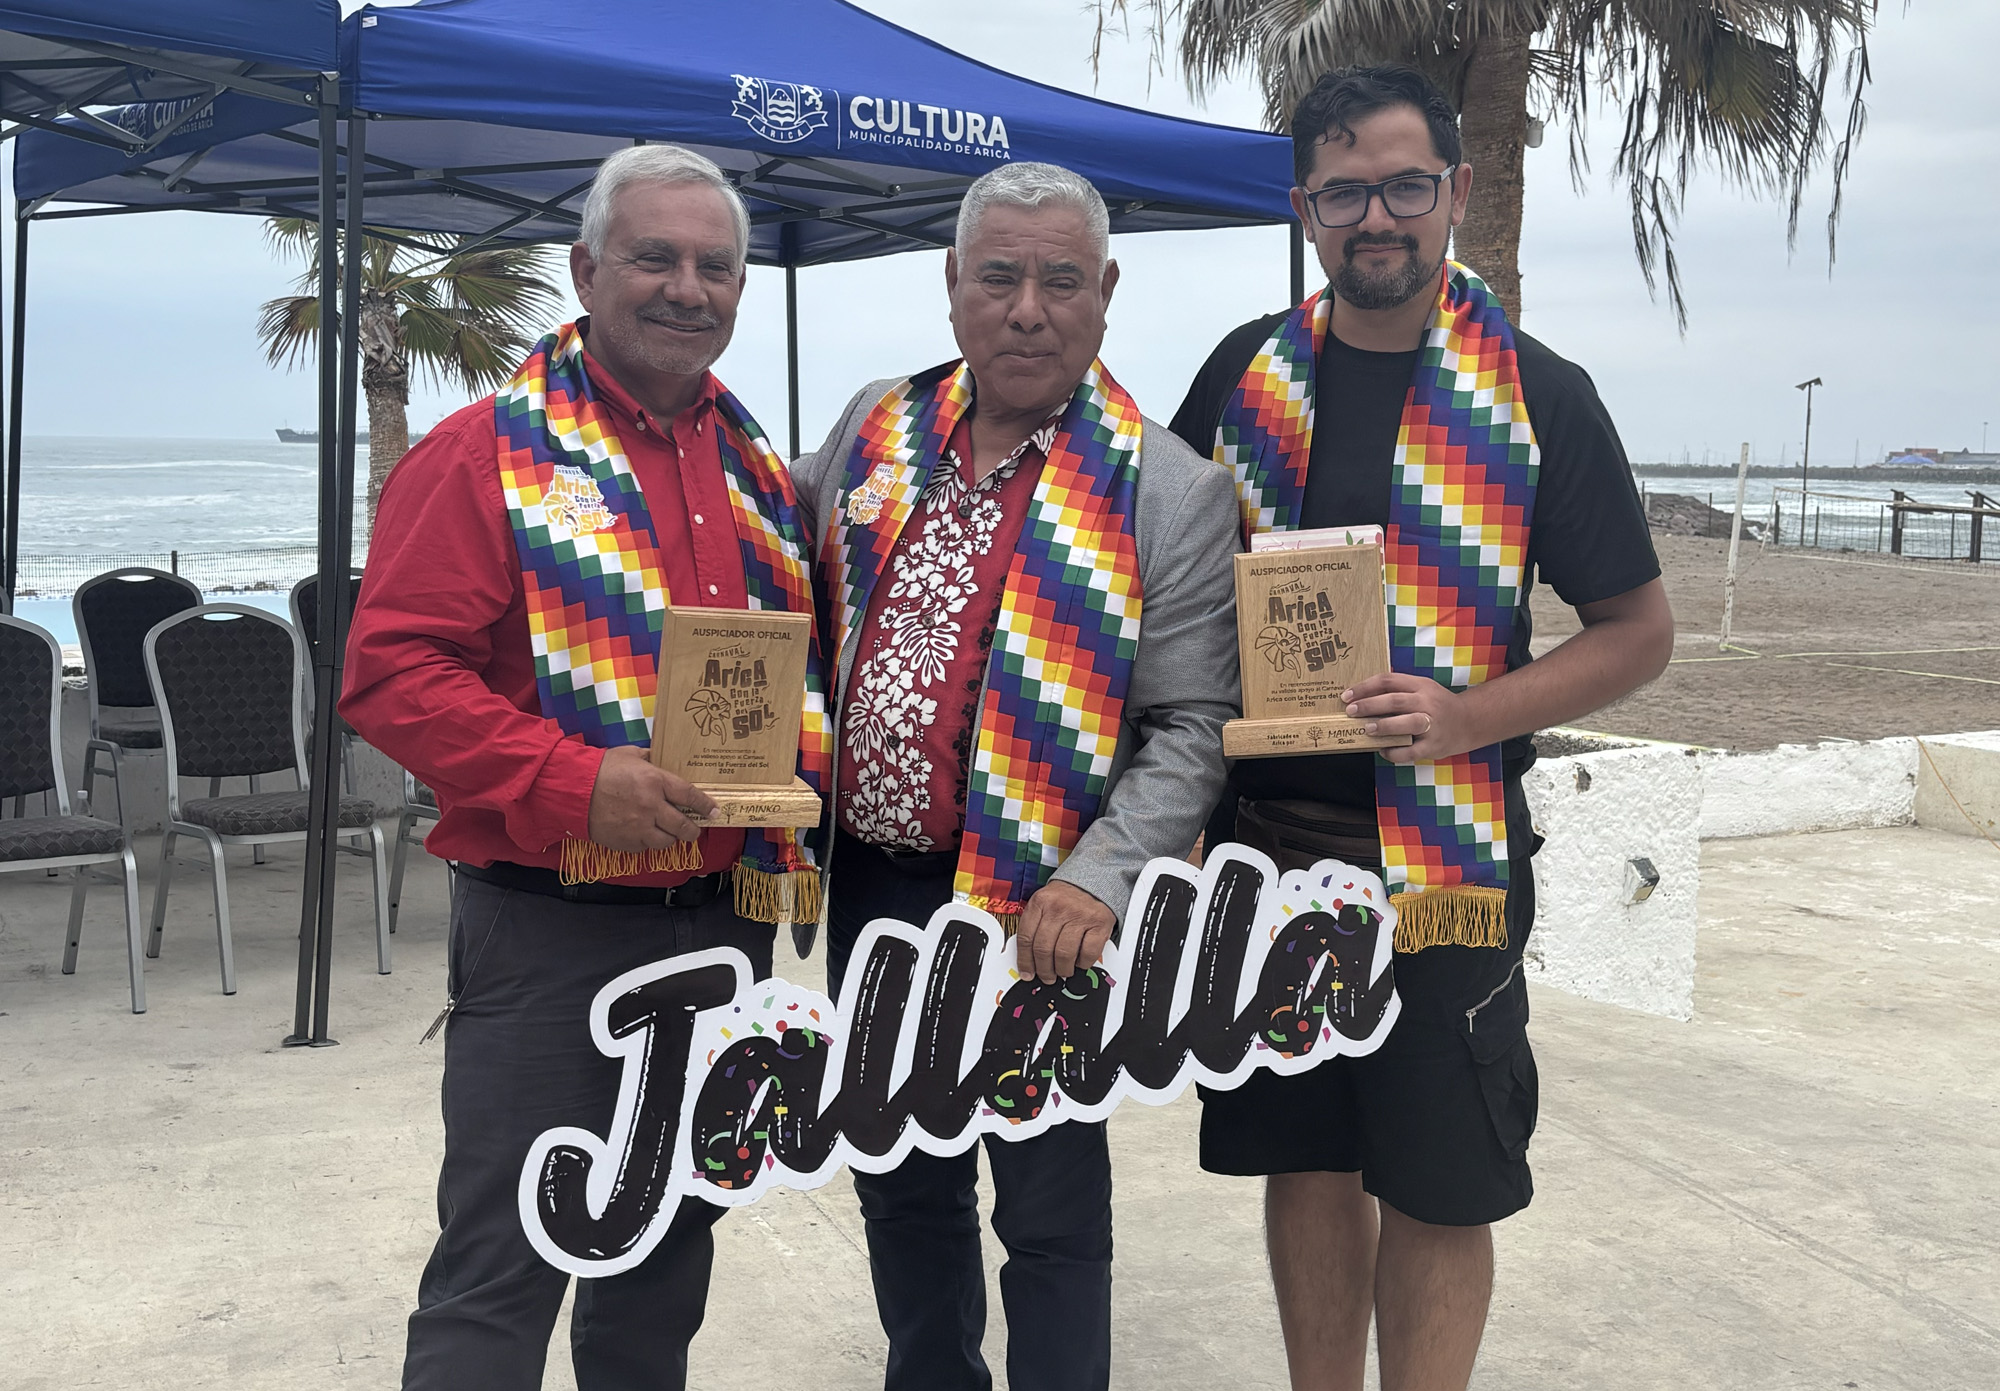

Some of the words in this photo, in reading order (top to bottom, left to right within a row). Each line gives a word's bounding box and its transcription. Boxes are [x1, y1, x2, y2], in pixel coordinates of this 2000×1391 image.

[760, 125, 803, 140] ARICA
[850, 96, 1009, 149] CULTURA
[850, 130, 951, 152] MUNICIPALIDAD
[955, 144, 971, 155] DE
[974, 147, 1010, 160] ARICA
[1250, 564, 1313, 577] AUSPICIADOR
[1315, 562, 1352, 572] OFICIAL
[692, 628, 755, 639] AUSPICIADOR
[757, 630, 792, 640] OFICIAL
[1304, 634, 1347, 672] SOL
[732, 703, 774, 740] SOL
[1328, 727, 1366, 738] MAINKO
[740, 804, 781, 814] MAINKO
[538, 859, 1394, 1260] Jallalla
